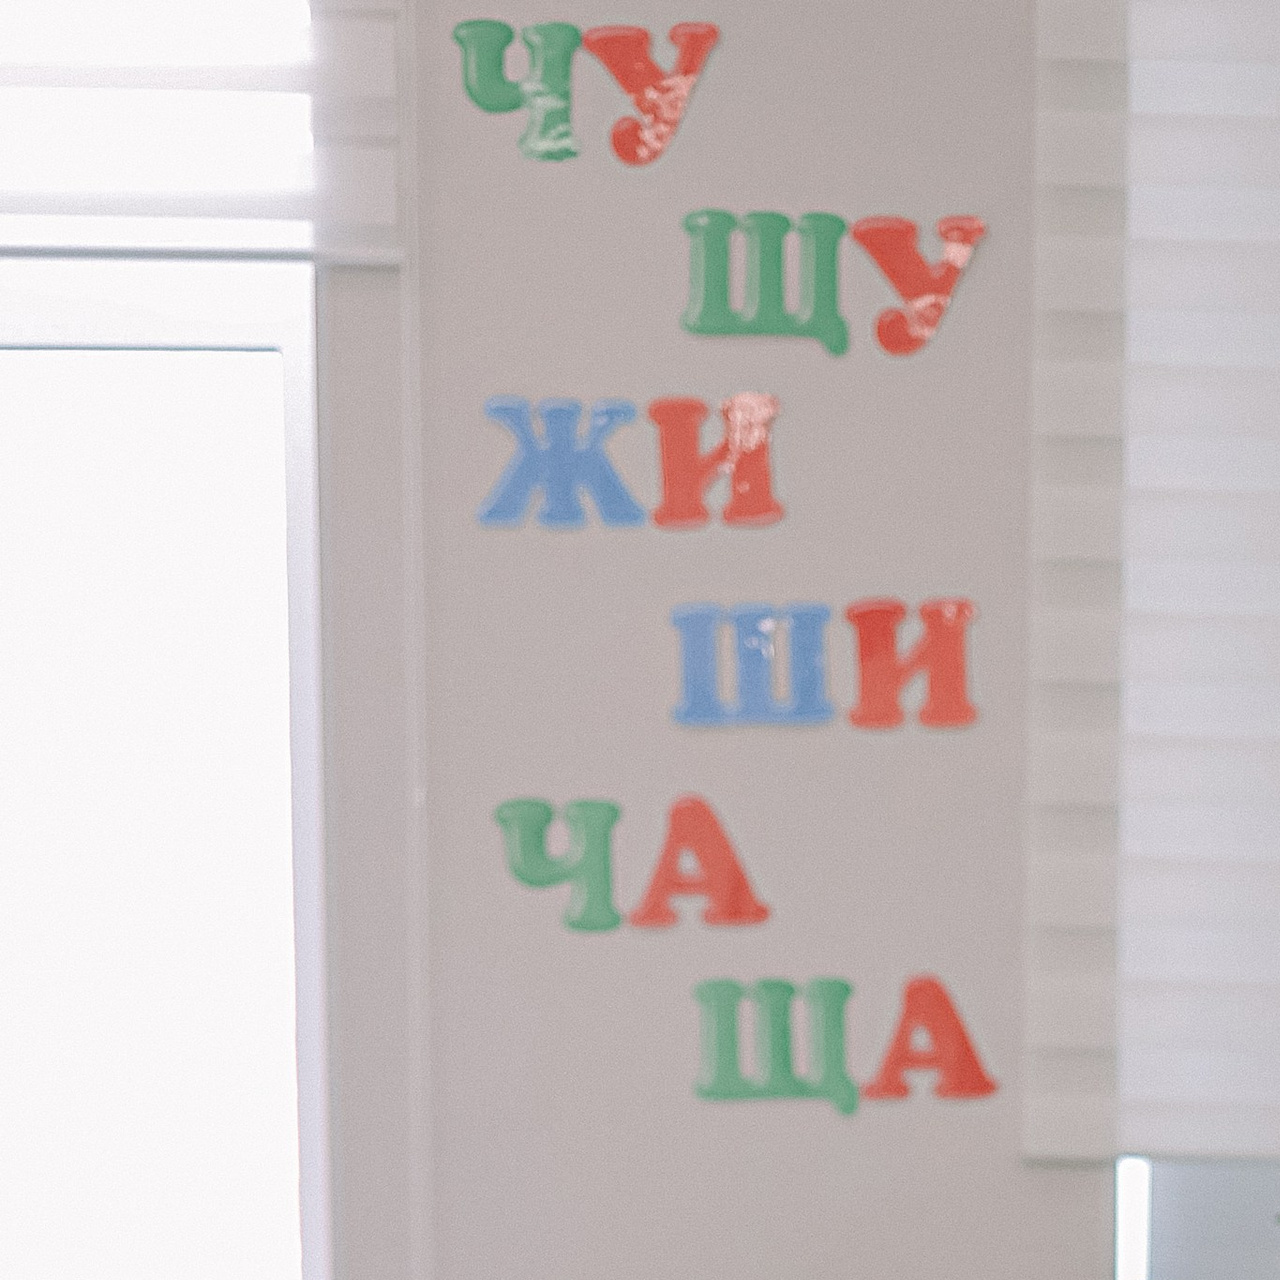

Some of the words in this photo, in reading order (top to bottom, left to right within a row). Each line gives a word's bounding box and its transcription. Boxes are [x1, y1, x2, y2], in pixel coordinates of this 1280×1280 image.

[453, 19, 720, 165] ЧУ
[681, 208, 986, 356] ЩУ
[478, 392, 785, 530] ЖИ
[672, 598, 978, 730] ШИ
[495, 795, 770, 932] ЧА
[694, 974, 999, 1115] ЩА
